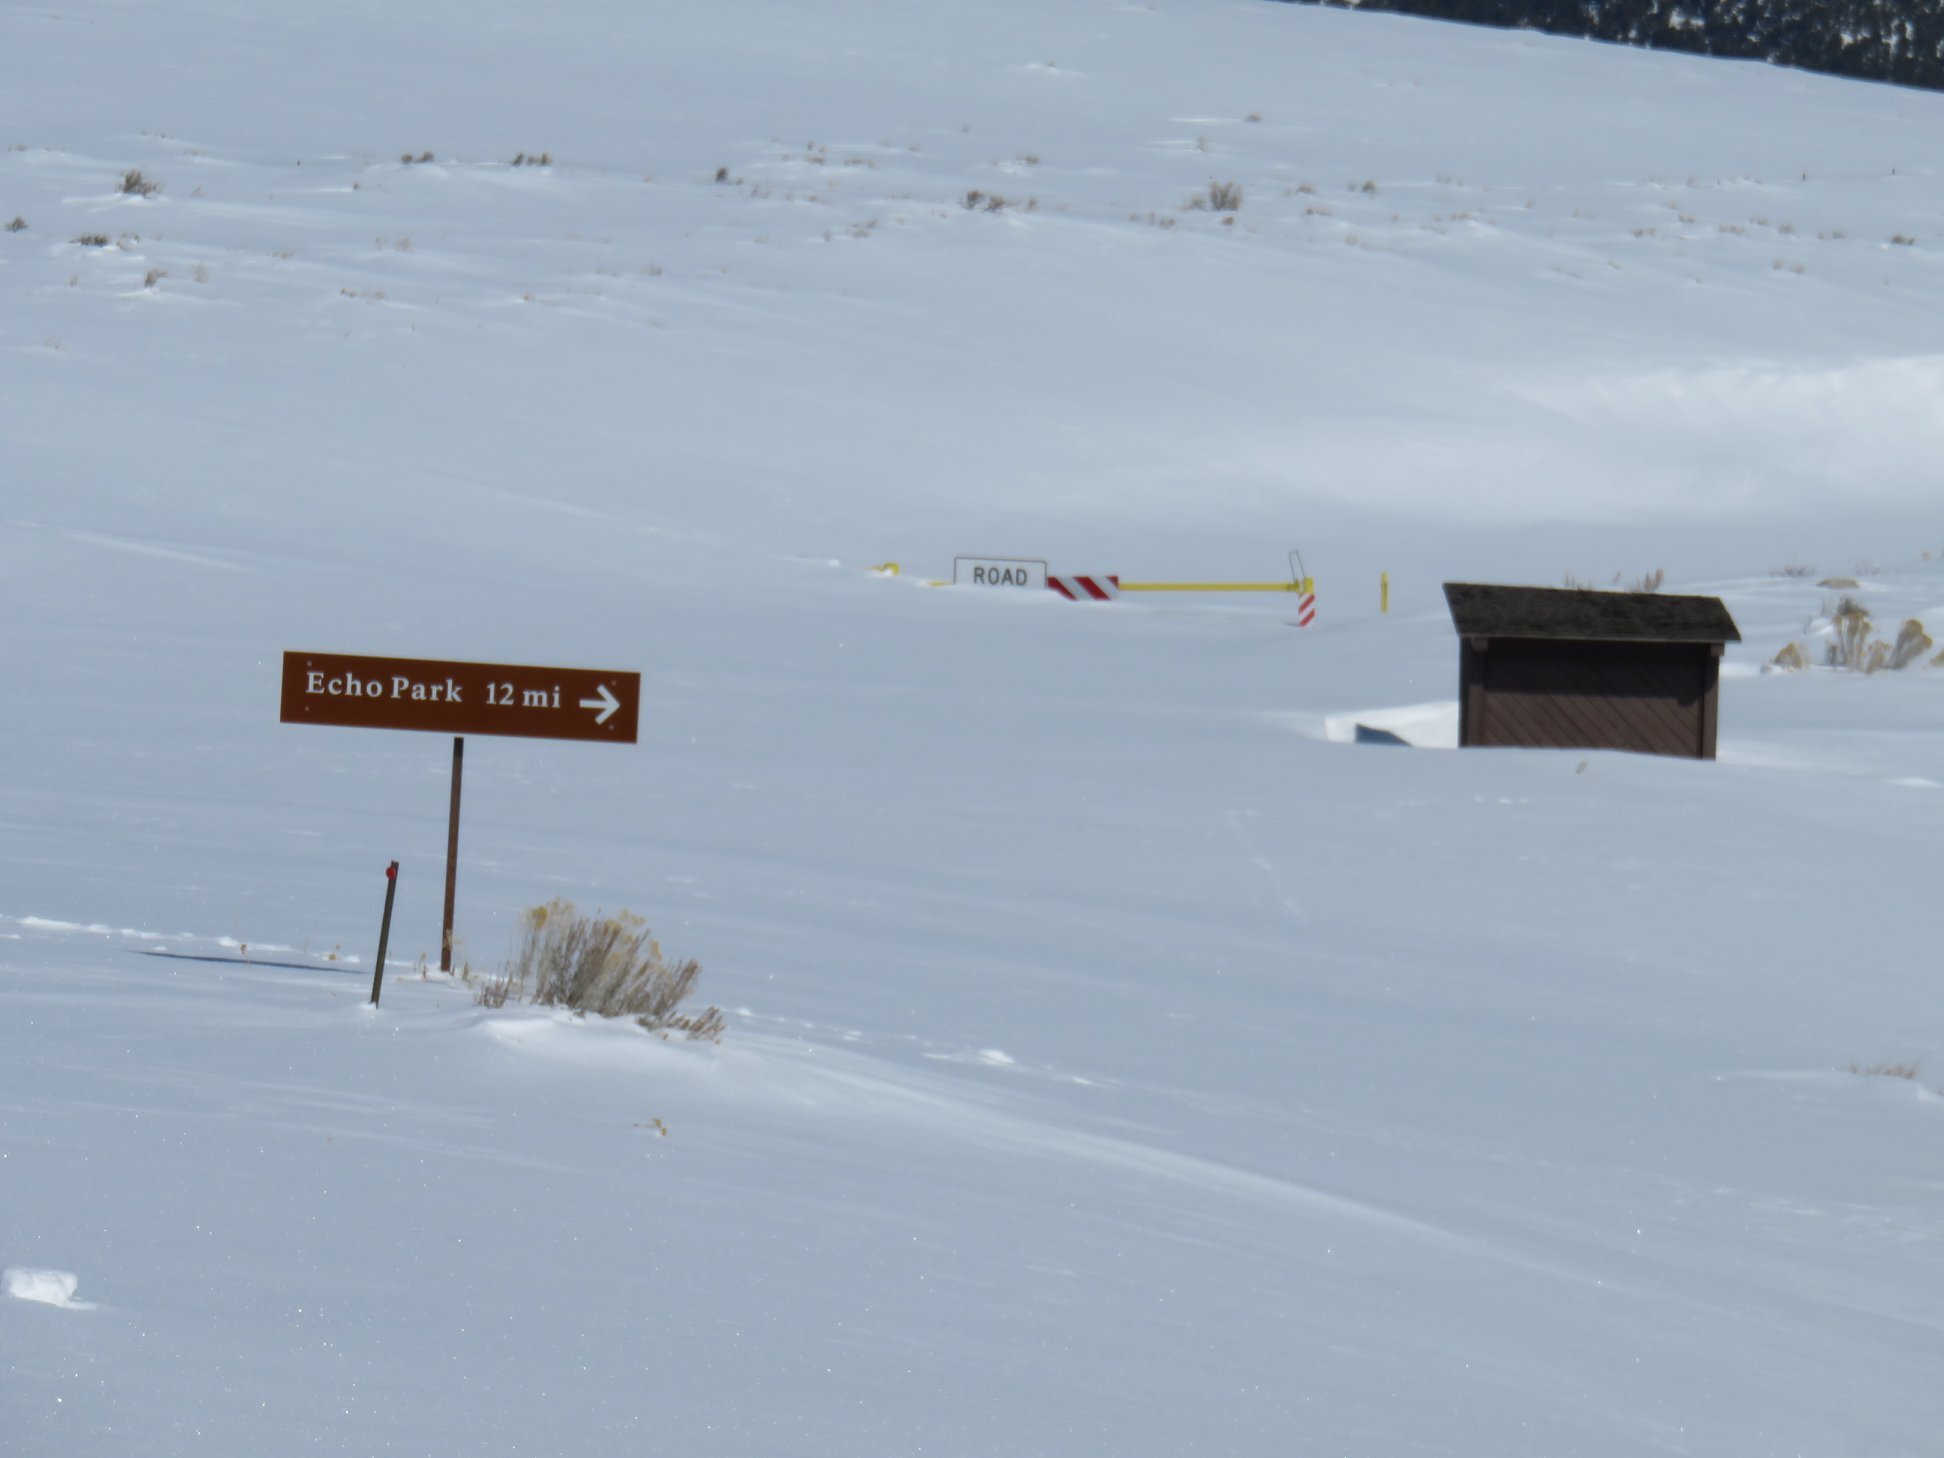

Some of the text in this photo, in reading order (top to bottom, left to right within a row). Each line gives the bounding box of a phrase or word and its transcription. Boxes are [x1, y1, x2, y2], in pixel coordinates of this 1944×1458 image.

[973, 567, 1028, 586] ROAD
[305, 670, 561, 709] Echo Park 12 mi
